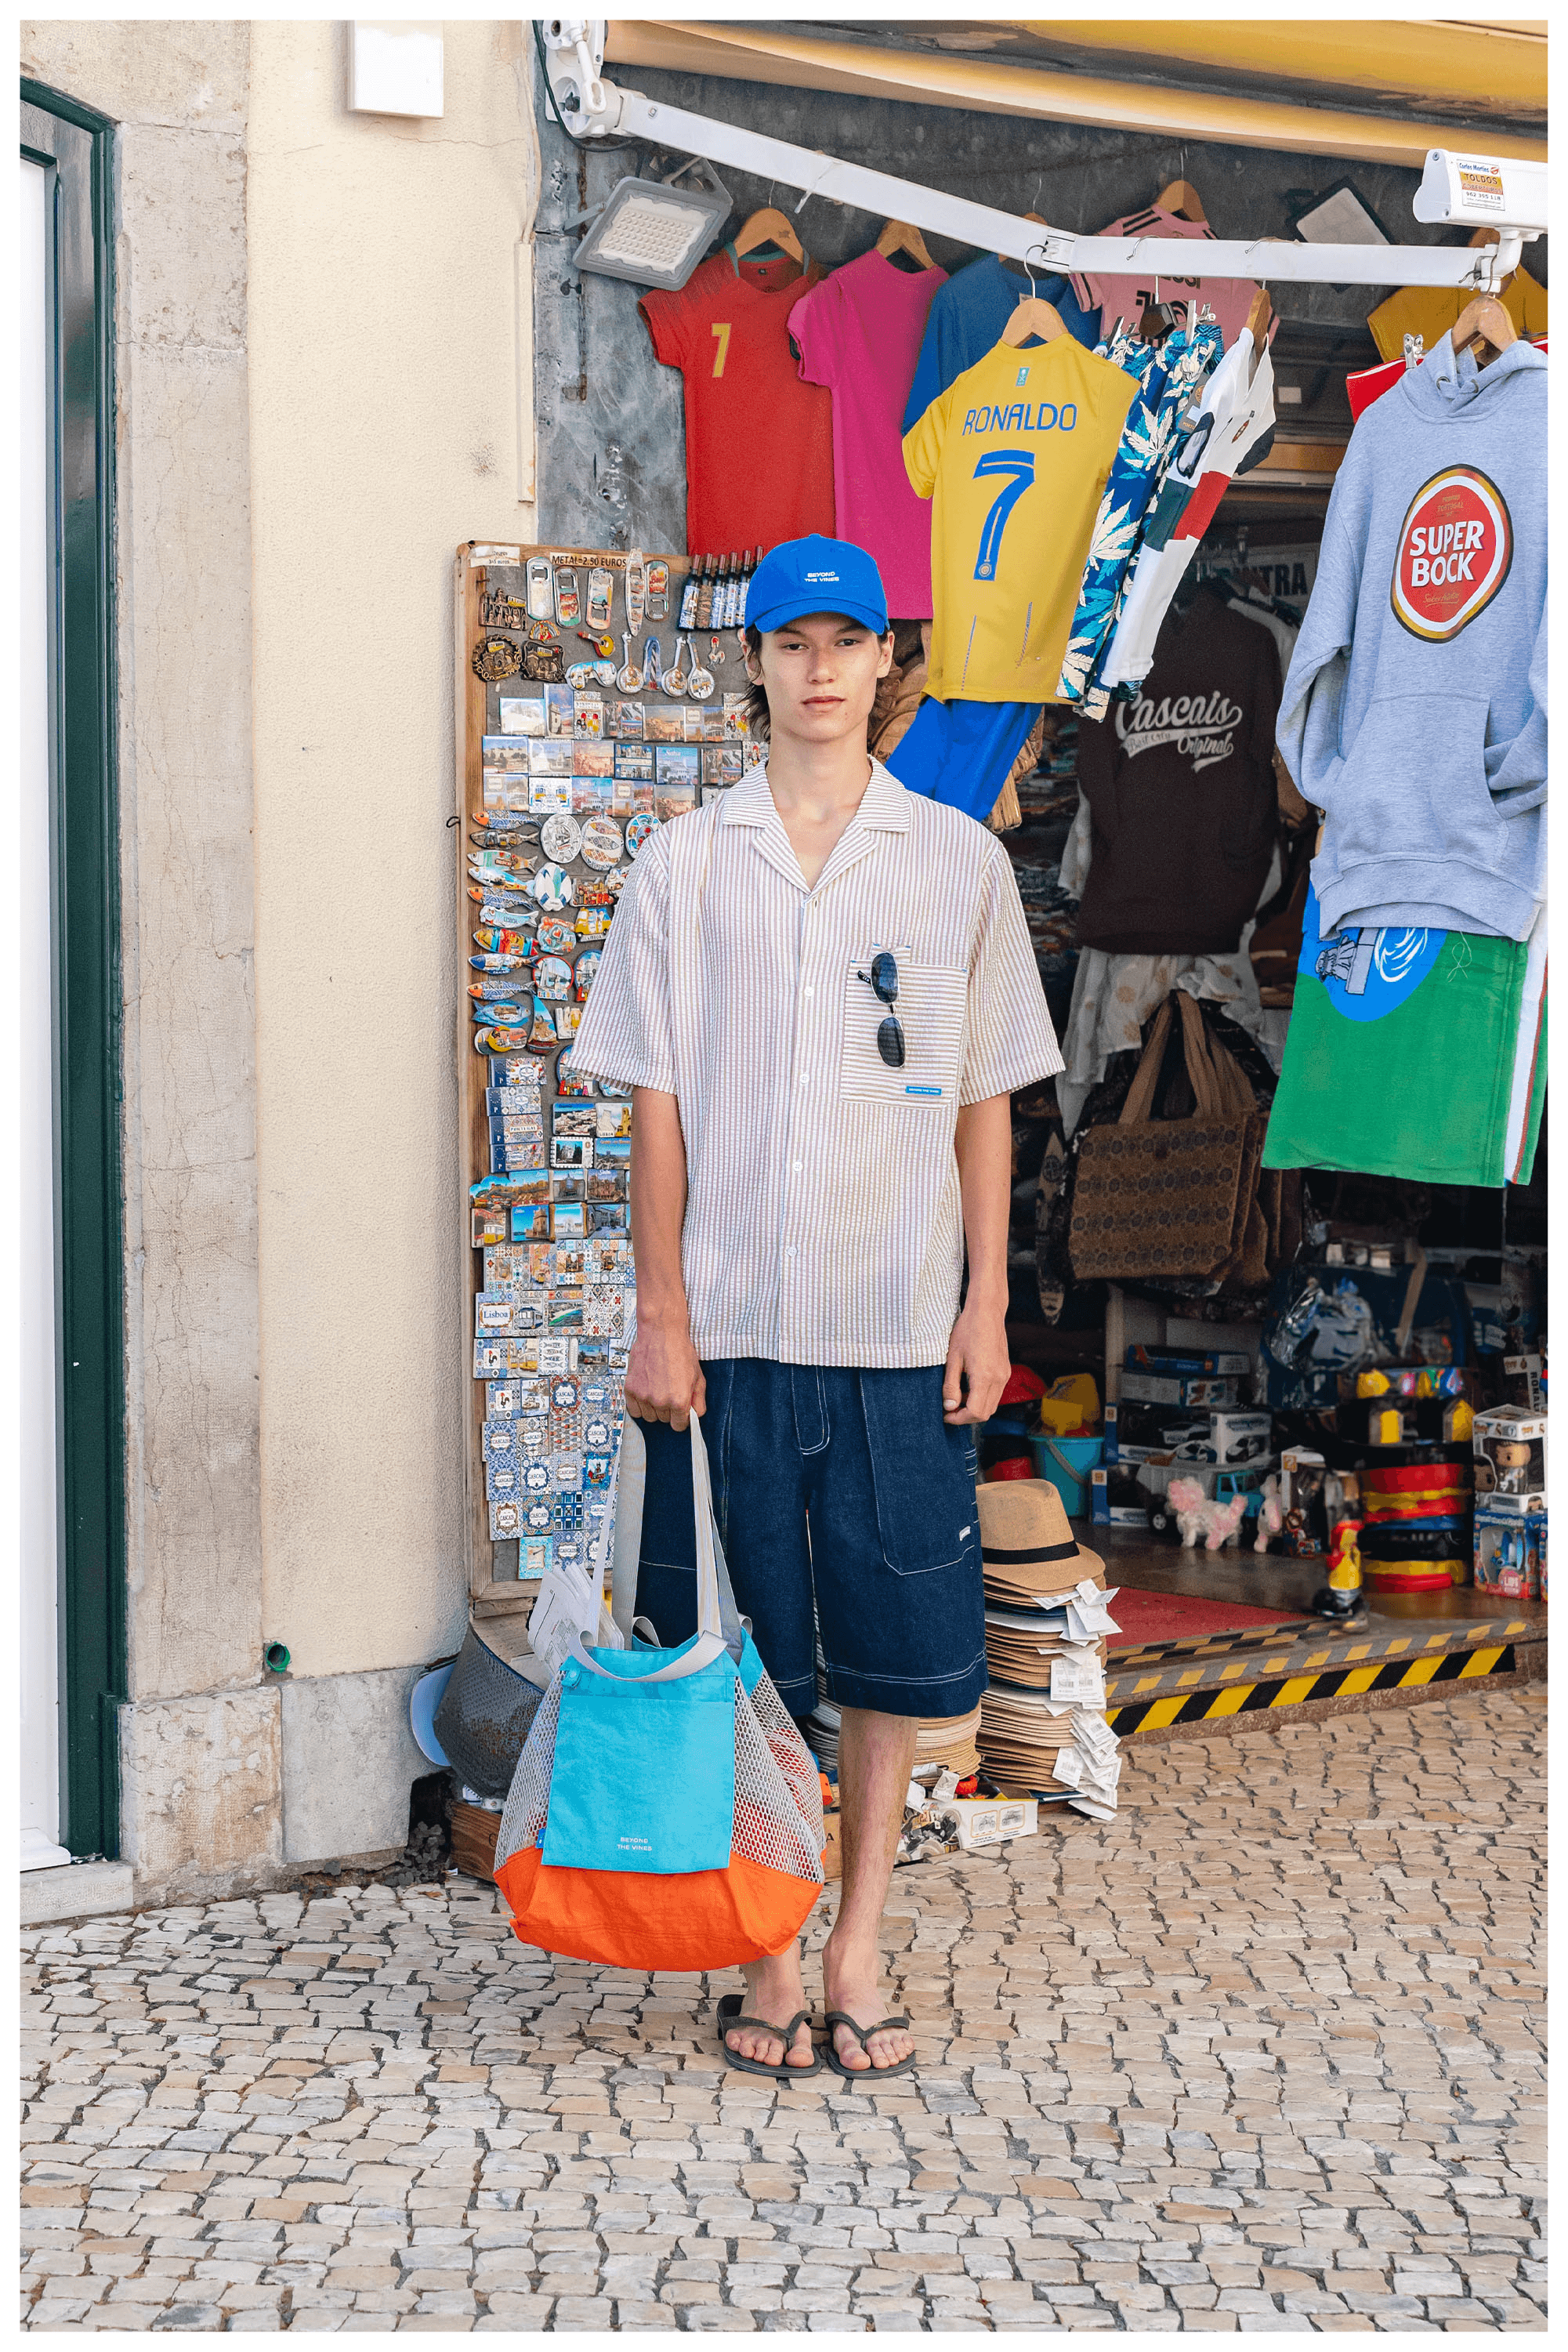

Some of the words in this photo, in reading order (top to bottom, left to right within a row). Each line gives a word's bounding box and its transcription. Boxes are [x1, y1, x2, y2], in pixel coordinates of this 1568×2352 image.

[1464, 173, 1497, 185] TOLDOS
[712, 323, 731, 378] 7
[962, 403, 1077, 436] RONALDO
[972, 449, 1035, 582] 7
[1410, 520, 1486, 557] SUPER
[601, 557, 627, 567] EUROS
[1411, 551, 1477, 587] BOCK
[1115, 690, 1243, 740] Cascais
[1178, 731, 1233, 759] Original
[538, 991, 568, 1000] LISBOA
[483, 1310, 508, 1319] Lisboa
[1530, 1372, 1540, 1412] RONAL
